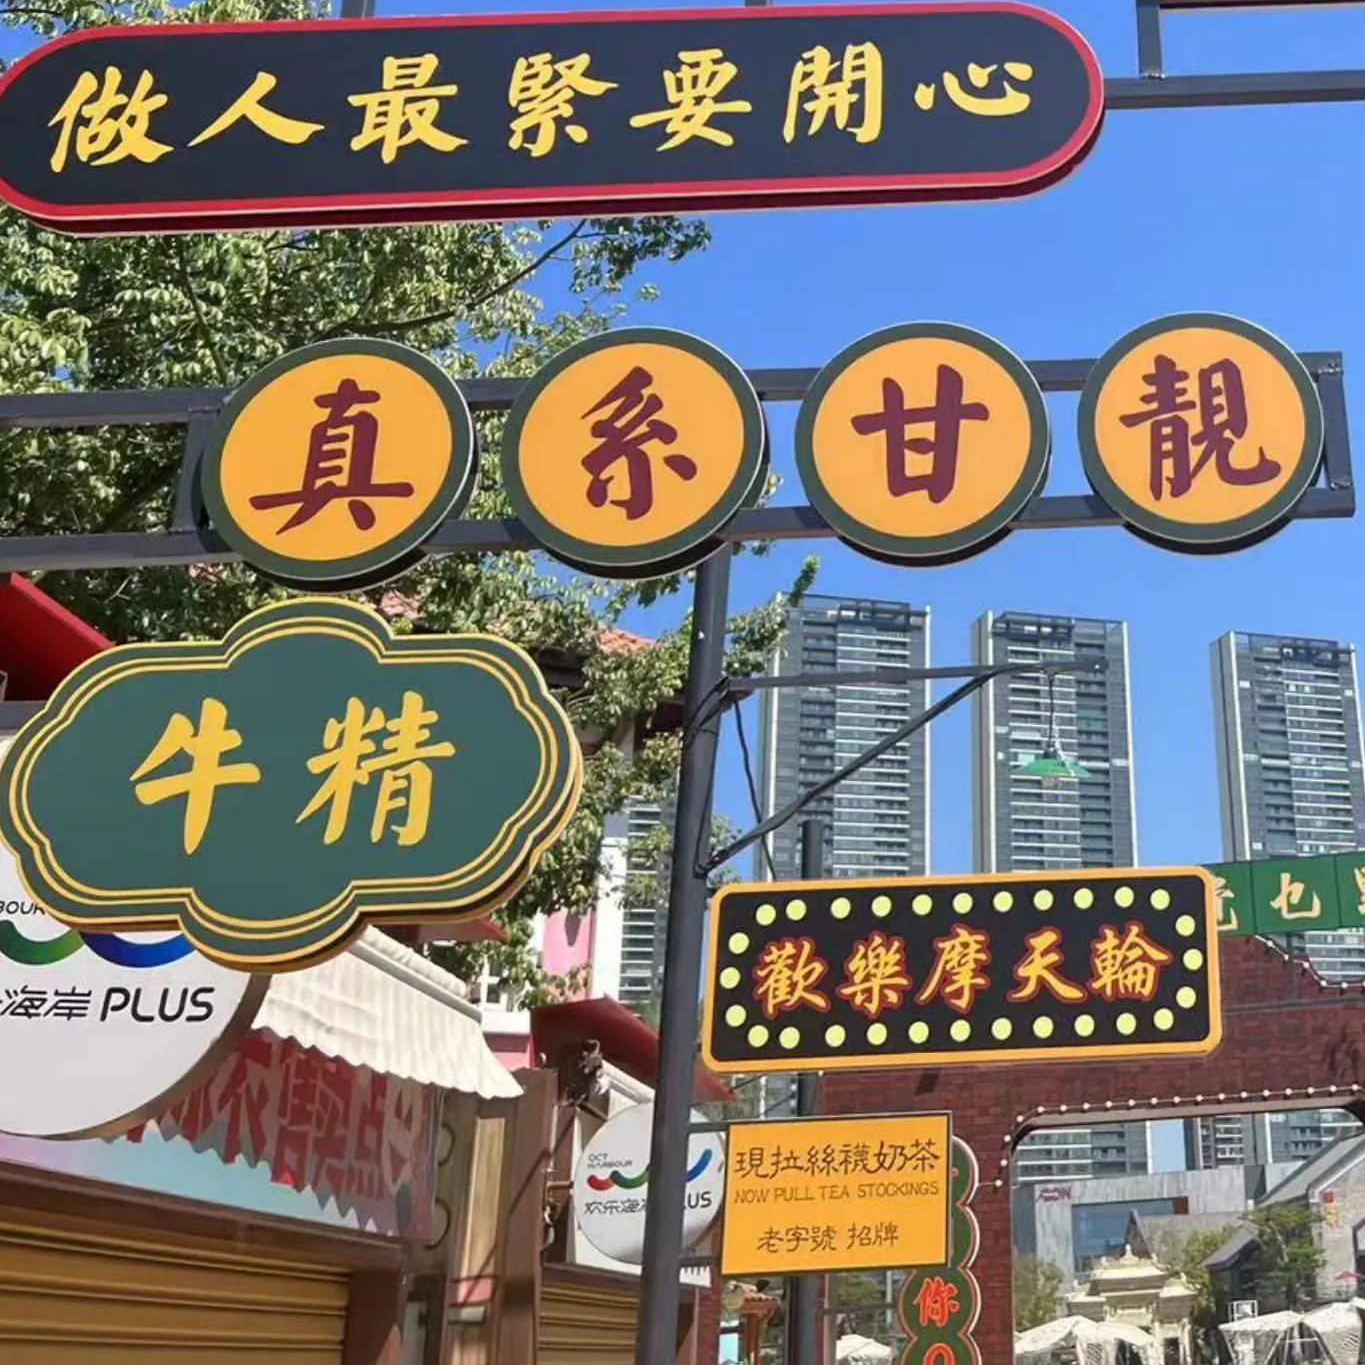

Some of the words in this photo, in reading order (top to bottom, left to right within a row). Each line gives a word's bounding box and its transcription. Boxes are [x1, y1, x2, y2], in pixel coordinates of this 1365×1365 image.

[48, 43, 1035, 173] 做人最緊要開心
[248, 354, 1282, 535] 真系甘靚
[130, 690, 457, 855] 牛精
[100, 987, 215, 1023] PLUS
[754, 920, 1174, 1020] 歡樂摩天輪
[734, 1188, 770, 1204] NOW
[774, 1187, 814, 1203] PULL
[818, 1185, 850, 1200] TEA
[757, 1226, 838, 1253] 老字號
[847, 1221, 899, 1250] 招牌
